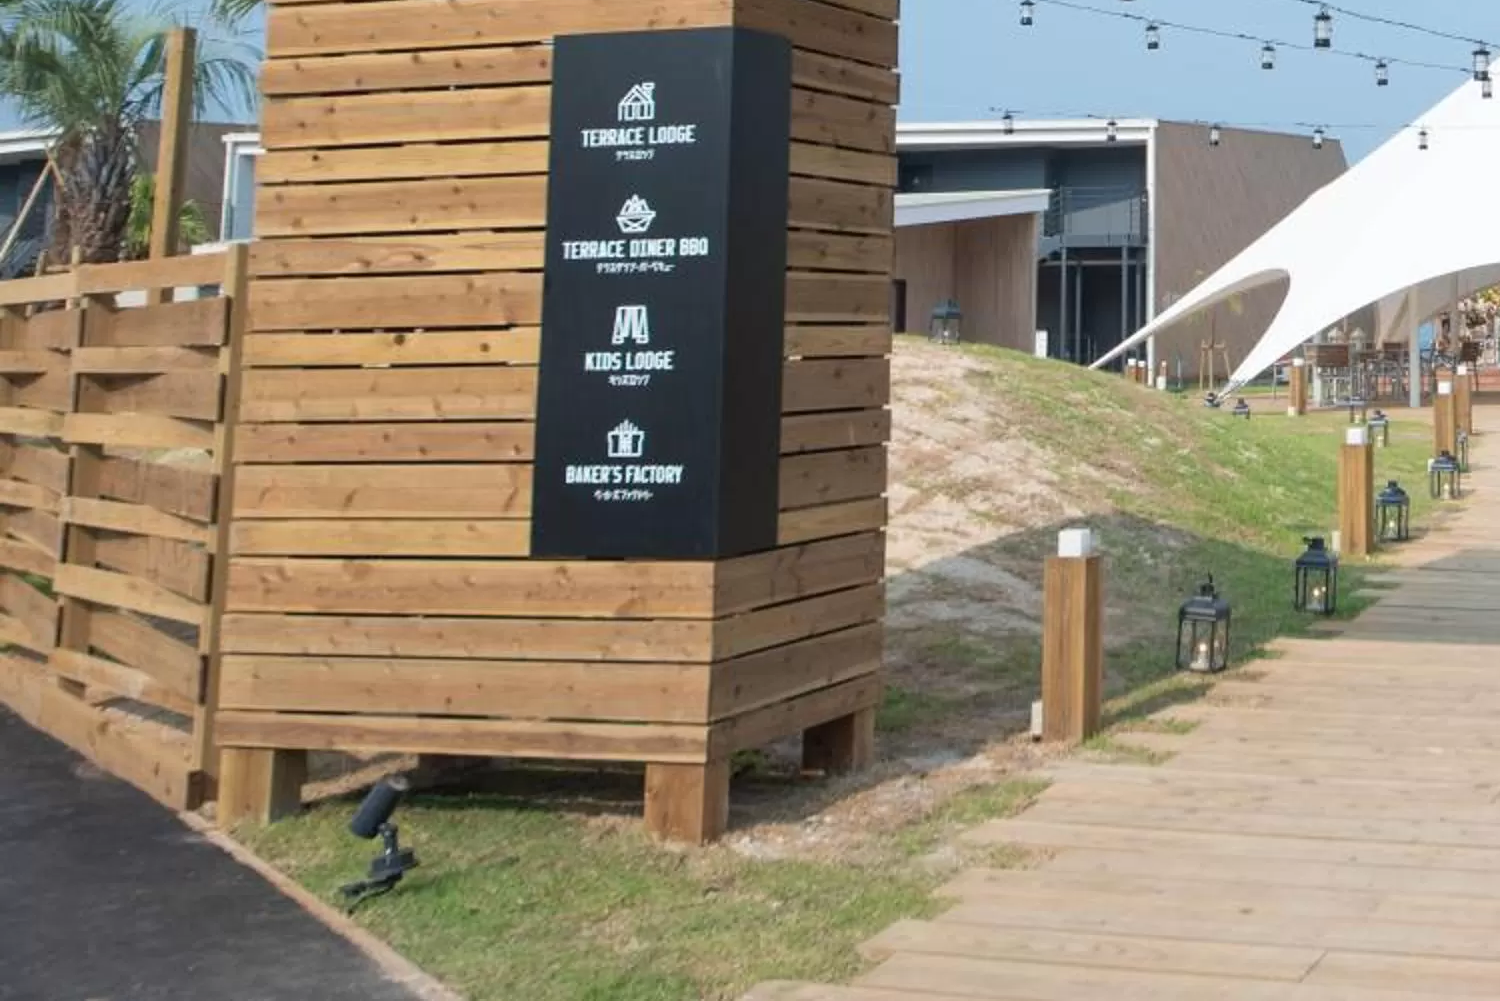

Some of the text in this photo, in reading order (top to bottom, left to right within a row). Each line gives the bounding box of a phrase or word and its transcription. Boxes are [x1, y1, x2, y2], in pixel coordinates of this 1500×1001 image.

[581, 124, 696, 147] TERRACE LODGE
[562, 236, 709, 260] TERRACE DINER BBQ
[584, 350, 675, 371] KIDS LODGE
[565, 464, 684, 484] BAKER'S FACTORY
